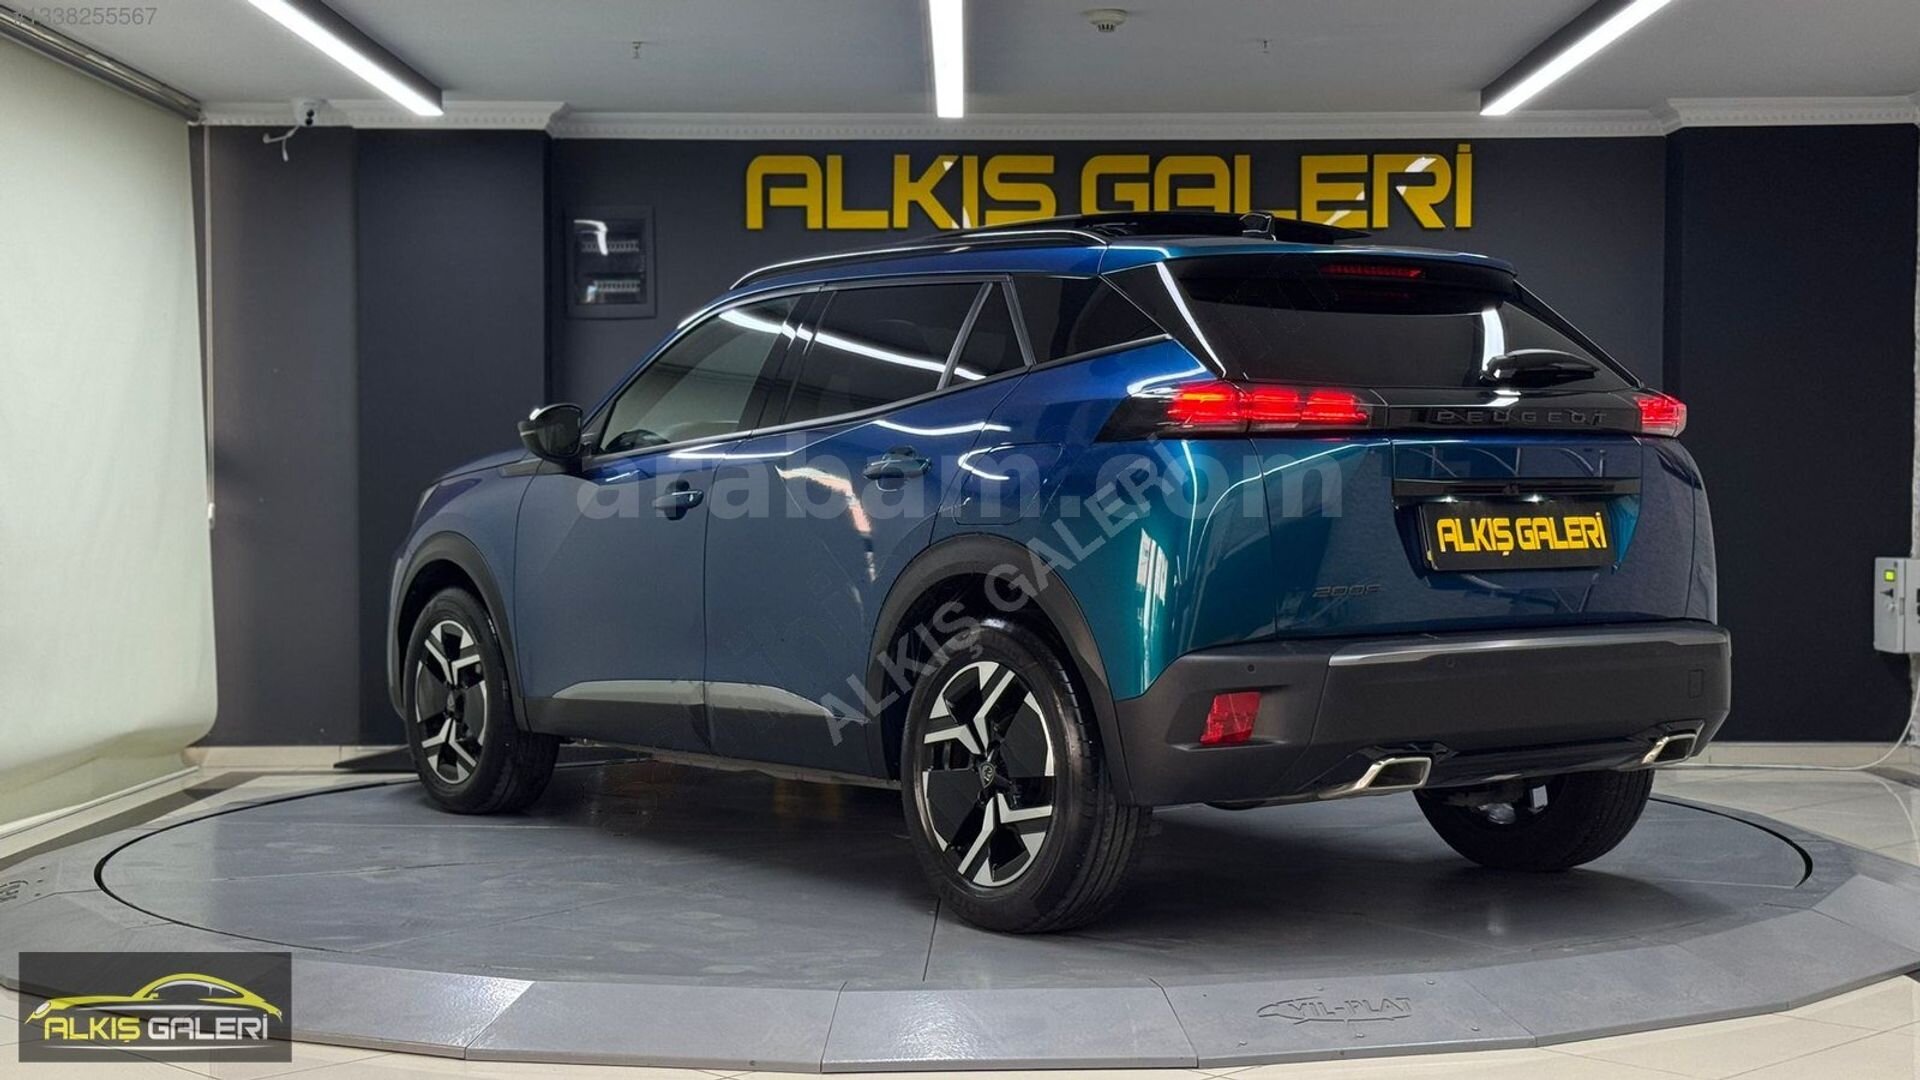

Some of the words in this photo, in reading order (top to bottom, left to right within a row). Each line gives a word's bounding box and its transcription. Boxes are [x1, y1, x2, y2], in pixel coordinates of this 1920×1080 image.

[1437, 410, 1607, 424] PEUGEOT
[1436, 517, 1515, 556] ALKIŞ
[1516, 512, 1607, 551] GALERİ
